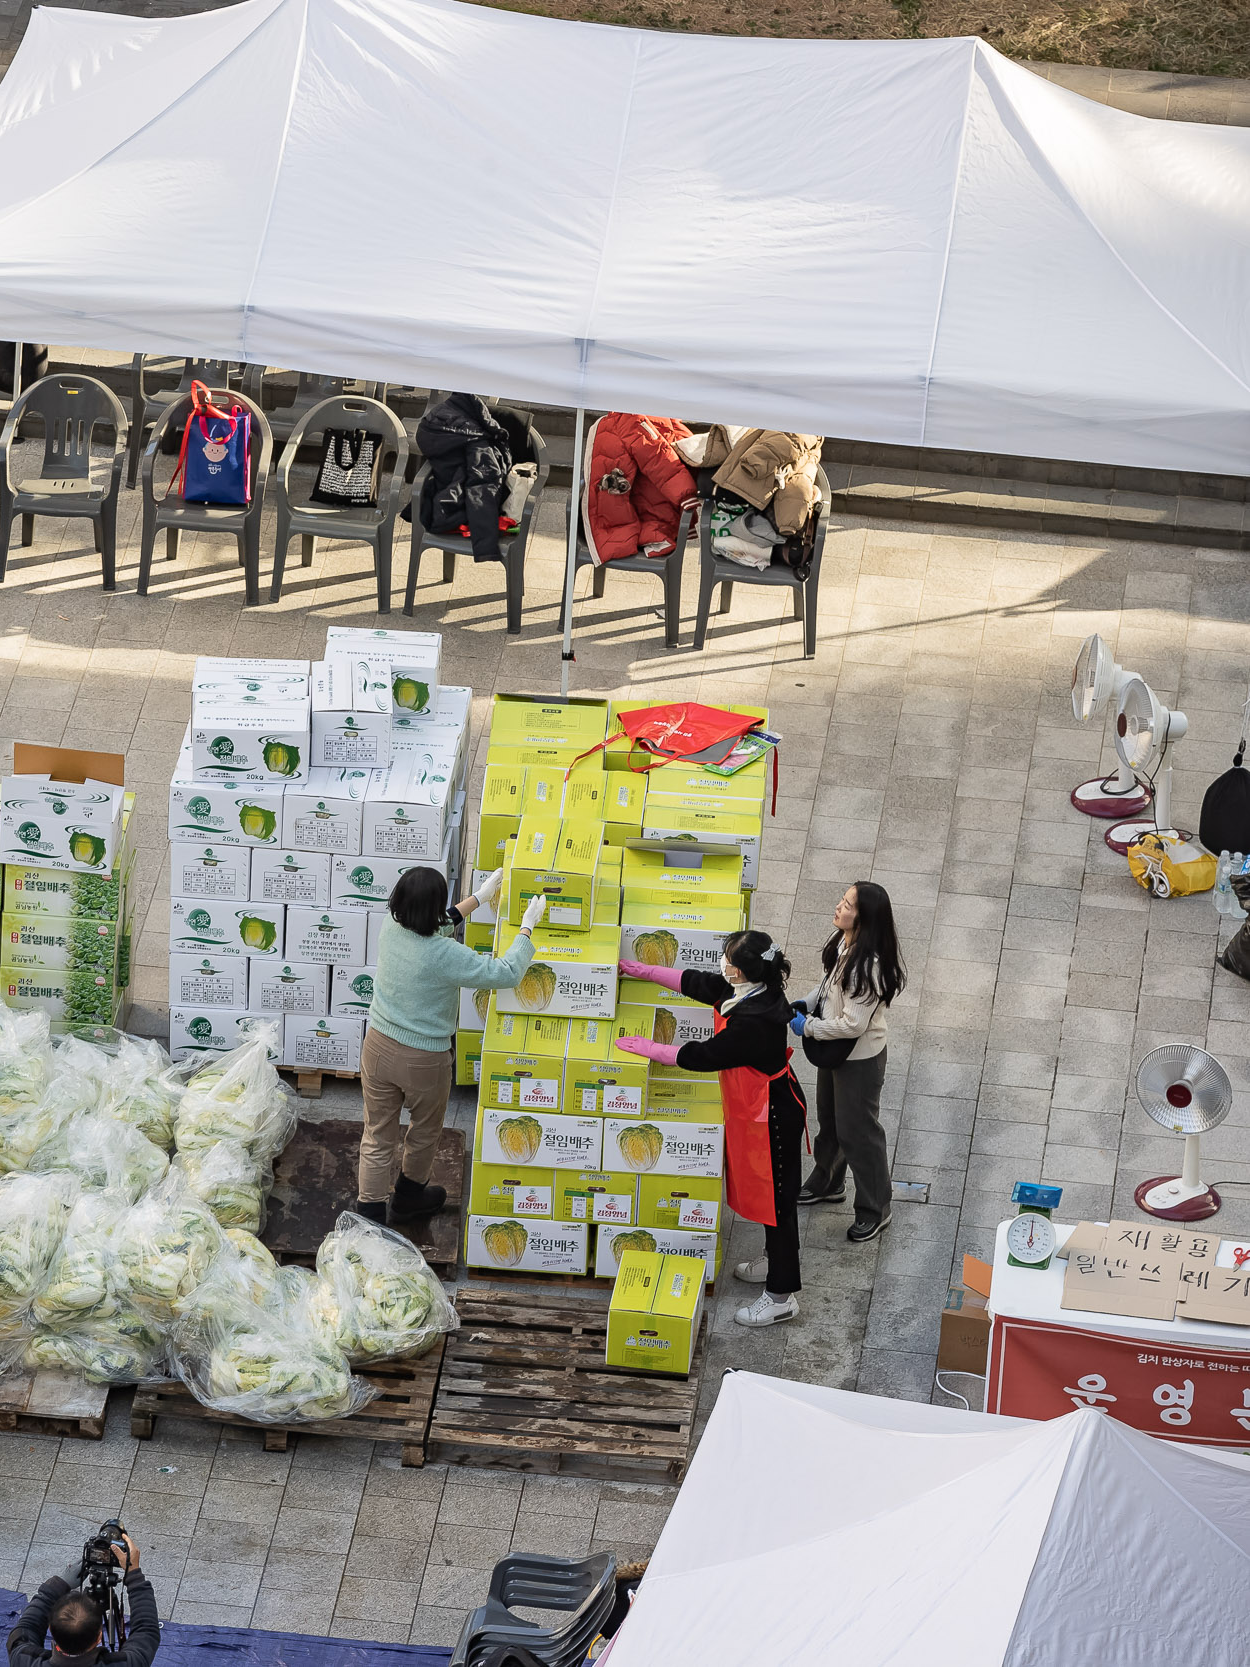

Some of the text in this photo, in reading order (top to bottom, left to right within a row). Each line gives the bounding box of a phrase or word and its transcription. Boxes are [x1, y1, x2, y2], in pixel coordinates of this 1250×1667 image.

[52, 860, 70, 868] 20kg
[24, 872, 39, 880] 괴산
[24, 880, 70, 893] 절임배추
[20, 934, 66, 947] 절임배추
[18, 986, 64, 998] 절임배추
[558, 982, 609, 996] 절임배추
[524, 1094, 554, 1102] 김장양념
[607, 1100, 638, 1109] 김장양념
[544, 1134, 594, 1149] 절임배추
[664, 1142, 716, 1156] 절임배추
[518, 1202, 548, 1210] 김장양념
[597, 1210, 627, 1218] 김장양념
[683, 1215, 713, 1224] 김장양념
[529, 1238, 580, 1252] 절임배추
[638, 1337, 671, 1350] 절임배추
[1138, 1353, 1240, 1372] 김치 한상자로 전하는
